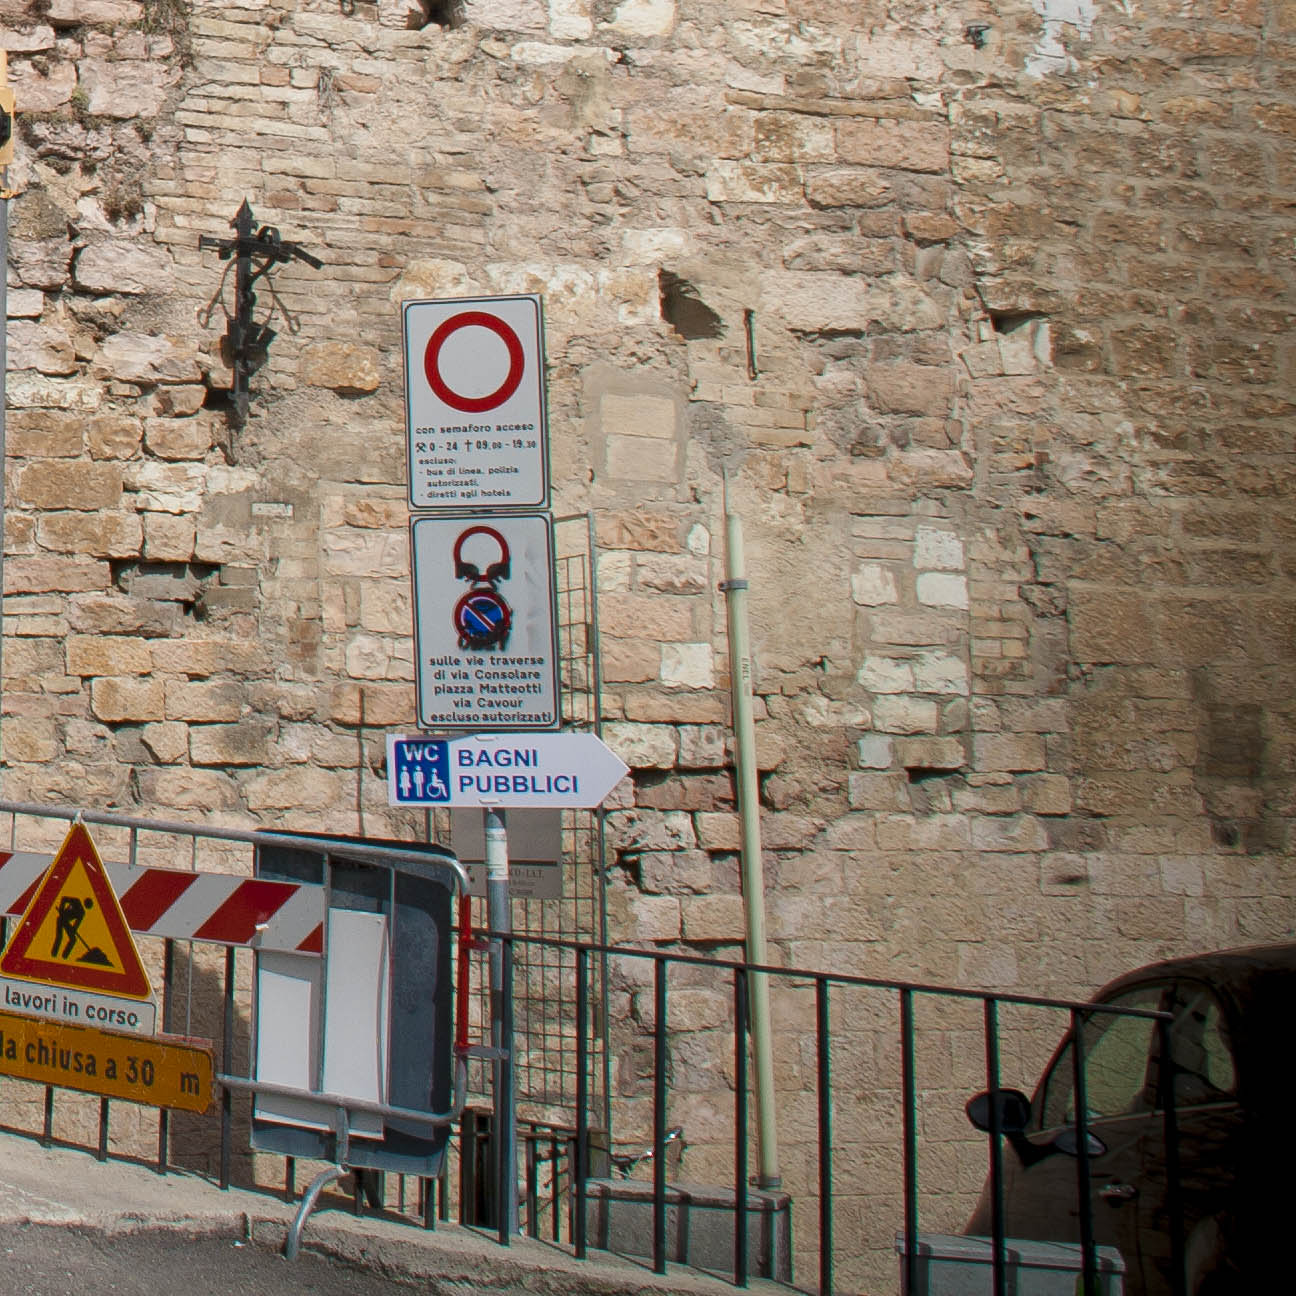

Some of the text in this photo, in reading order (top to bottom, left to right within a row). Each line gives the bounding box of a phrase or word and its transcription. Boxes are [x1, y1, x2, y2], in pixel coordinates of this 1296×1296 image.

[415, 423, 534, 434] con semaforo acceso
[446, 442, 458, 451] 24
[426, 468, 443, 476] bus
[446, 467, 456, 475] di
[488, 466, 519, 475] polizia
[427, 490, 457, 498] diretti
[460, 489, 477, 499] agli
[480, 489, 512, 497] hotels
[429, 655, 545, 665] sulle vie traverse
[433, 669, 541, 680] di via Consolare
[434, 683, 542, 696] piazza Matteotti
[452, 697, 524, 708] via Cavour
[430, 711, 552, 722] escluso autorizzati
[402, 743, 440, 761] WC
[458, 749, 539, 768] BAGNI
[459, 775, 579, 793] PUBBLICI
[4, 985, 138, 1027] lavori in corso
[24, 1037, 97, 1077] chiusa
[104, 1056, 117, 1080] a
[124, 1054, 155, 1087] 30
[180, 1070, 200, 1096] m
